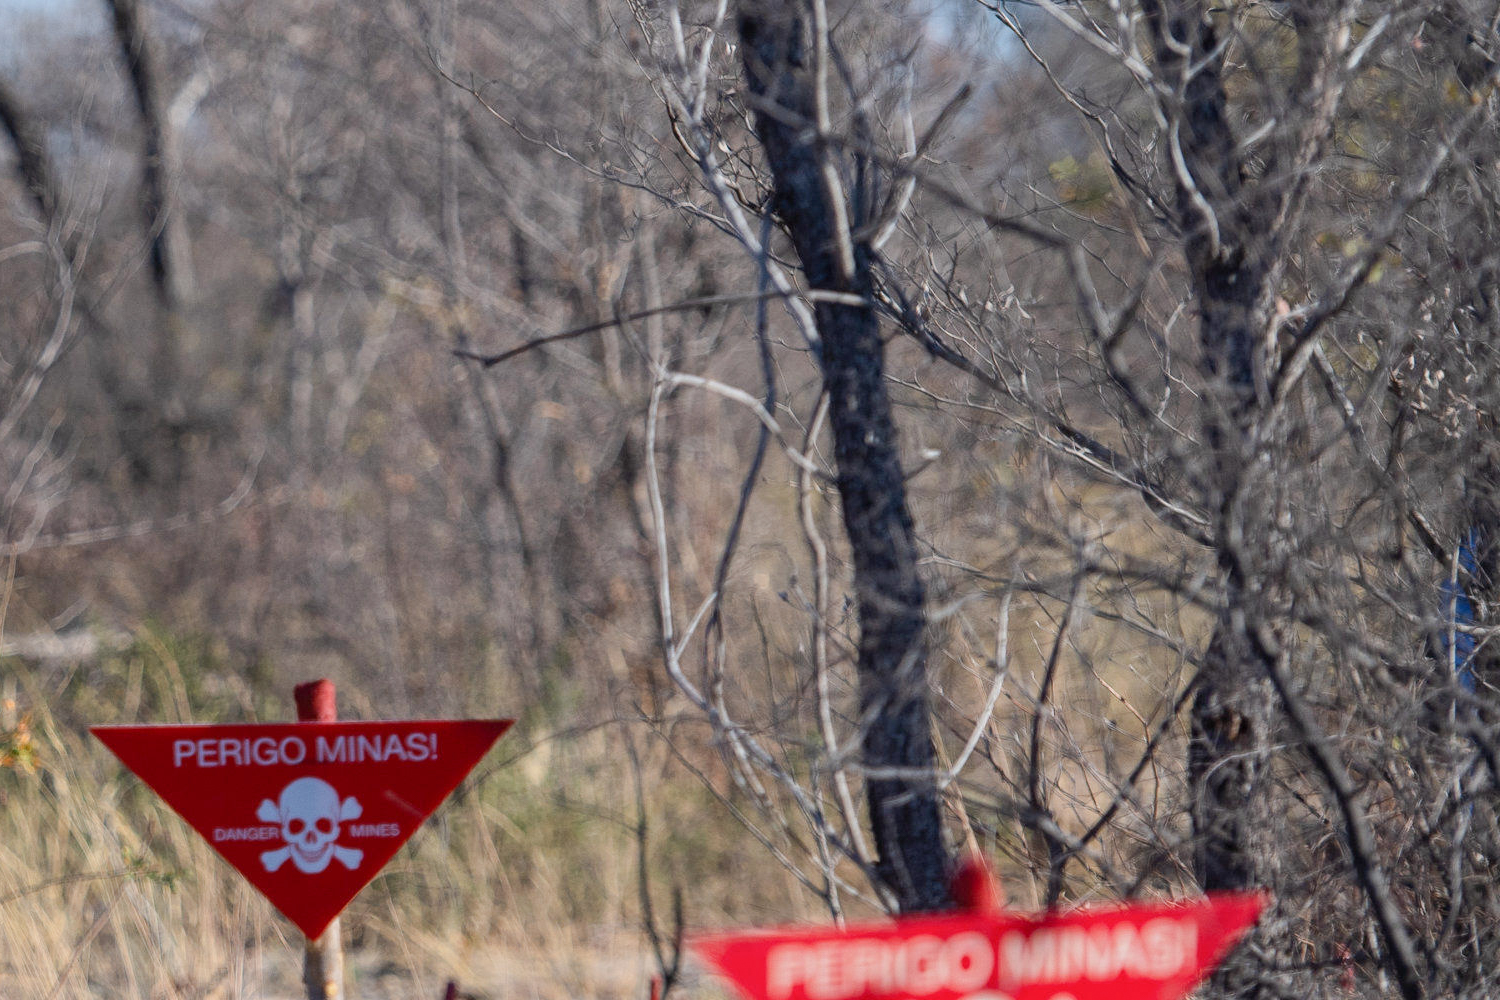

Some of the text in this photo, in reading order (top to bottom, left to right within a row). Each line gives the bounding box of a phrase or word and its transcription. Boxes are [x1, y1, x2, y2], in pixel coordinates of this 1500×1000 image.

[174, 733, 438, 767] PERIGO MINAS!
[214, 824, 400, 842] DANGER MINES
[767, 918, 1198, 1000] PERIGO MINAS!
